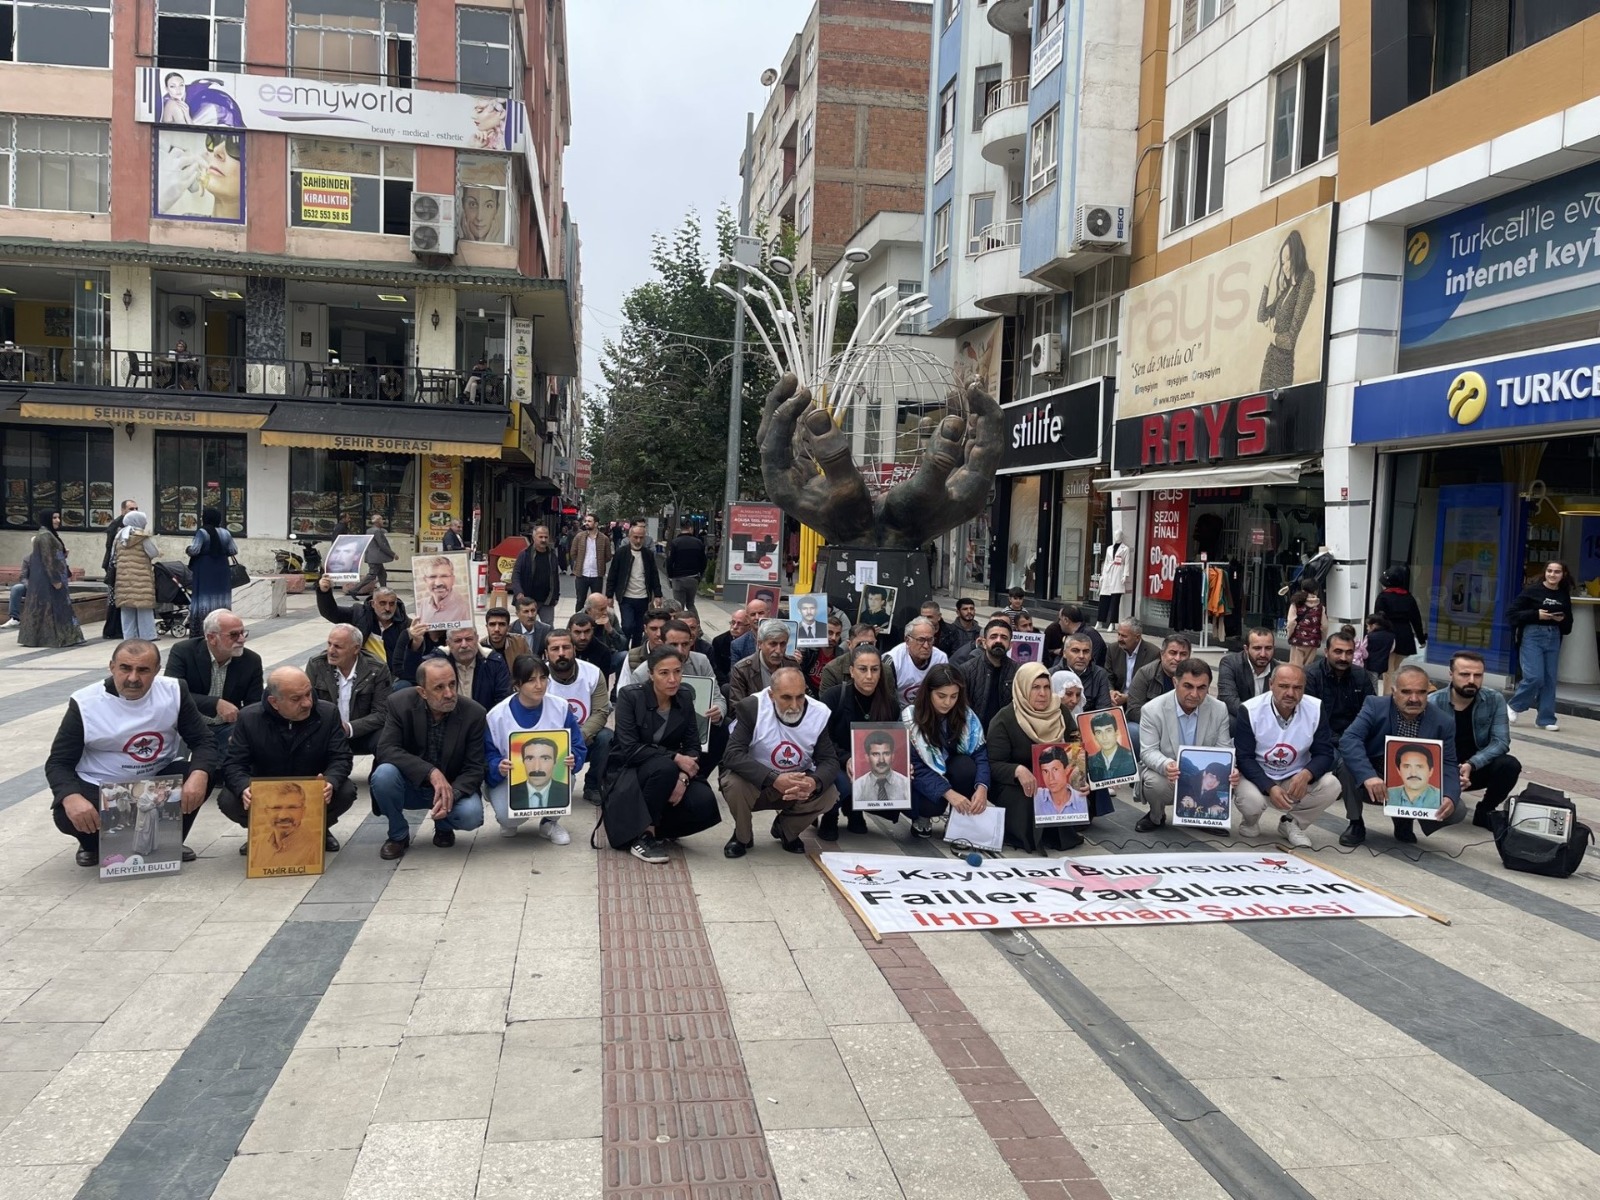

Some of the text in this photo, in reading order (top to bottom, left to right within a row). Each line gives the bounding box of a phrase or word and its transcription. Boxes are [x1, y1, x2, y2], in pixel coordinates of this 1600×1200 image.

[259, 84, 412, 114] esmyworld
[371, 125, 464, 141] beauty medical esthetic
[303, 176, 349, 190] SAHİBİNDEN
[303, 209, 349, 221] 0532 553 58 85
[1450, 205, 1555, 259] Turkcell'le
[1445, 247, 1539, 296] internet
[1127, 261, 1250, 359] rays
[1147, 356, 1156, 374] de
[1157, 349, 1182, 371] Mutlu
[1158, 391, 1195, 404] www.rays.com.tr
[94, 406, 196, 422] ŞEHİR SOFRASI
[1012, 403, 1061, 449] stilife
[1141, 395, 1267, 465] RAYS
[334, 436, 432, 451] ŞEHİR SOFRASI
[1154, 511, 1180, 523] SEZON
[1153, 523, 1179, 539] FİNALİ
[446, 620, 461, 629] ELÇİ
[533, 808, 567, 817] DEĞİRMENCİ
[106, 862, 177, 876] MERYEM BULUT
[263, 866, 306, 876] TAHİR ELÇİ
[897, 866, 1062, 882] Kayıplar
[1069, 864, 1260, 876] Bulunsun
[859, 883, 1364, 905] Failler Yargılansın
[910, 902, 1356, 926] İHD Batman Şubesi
